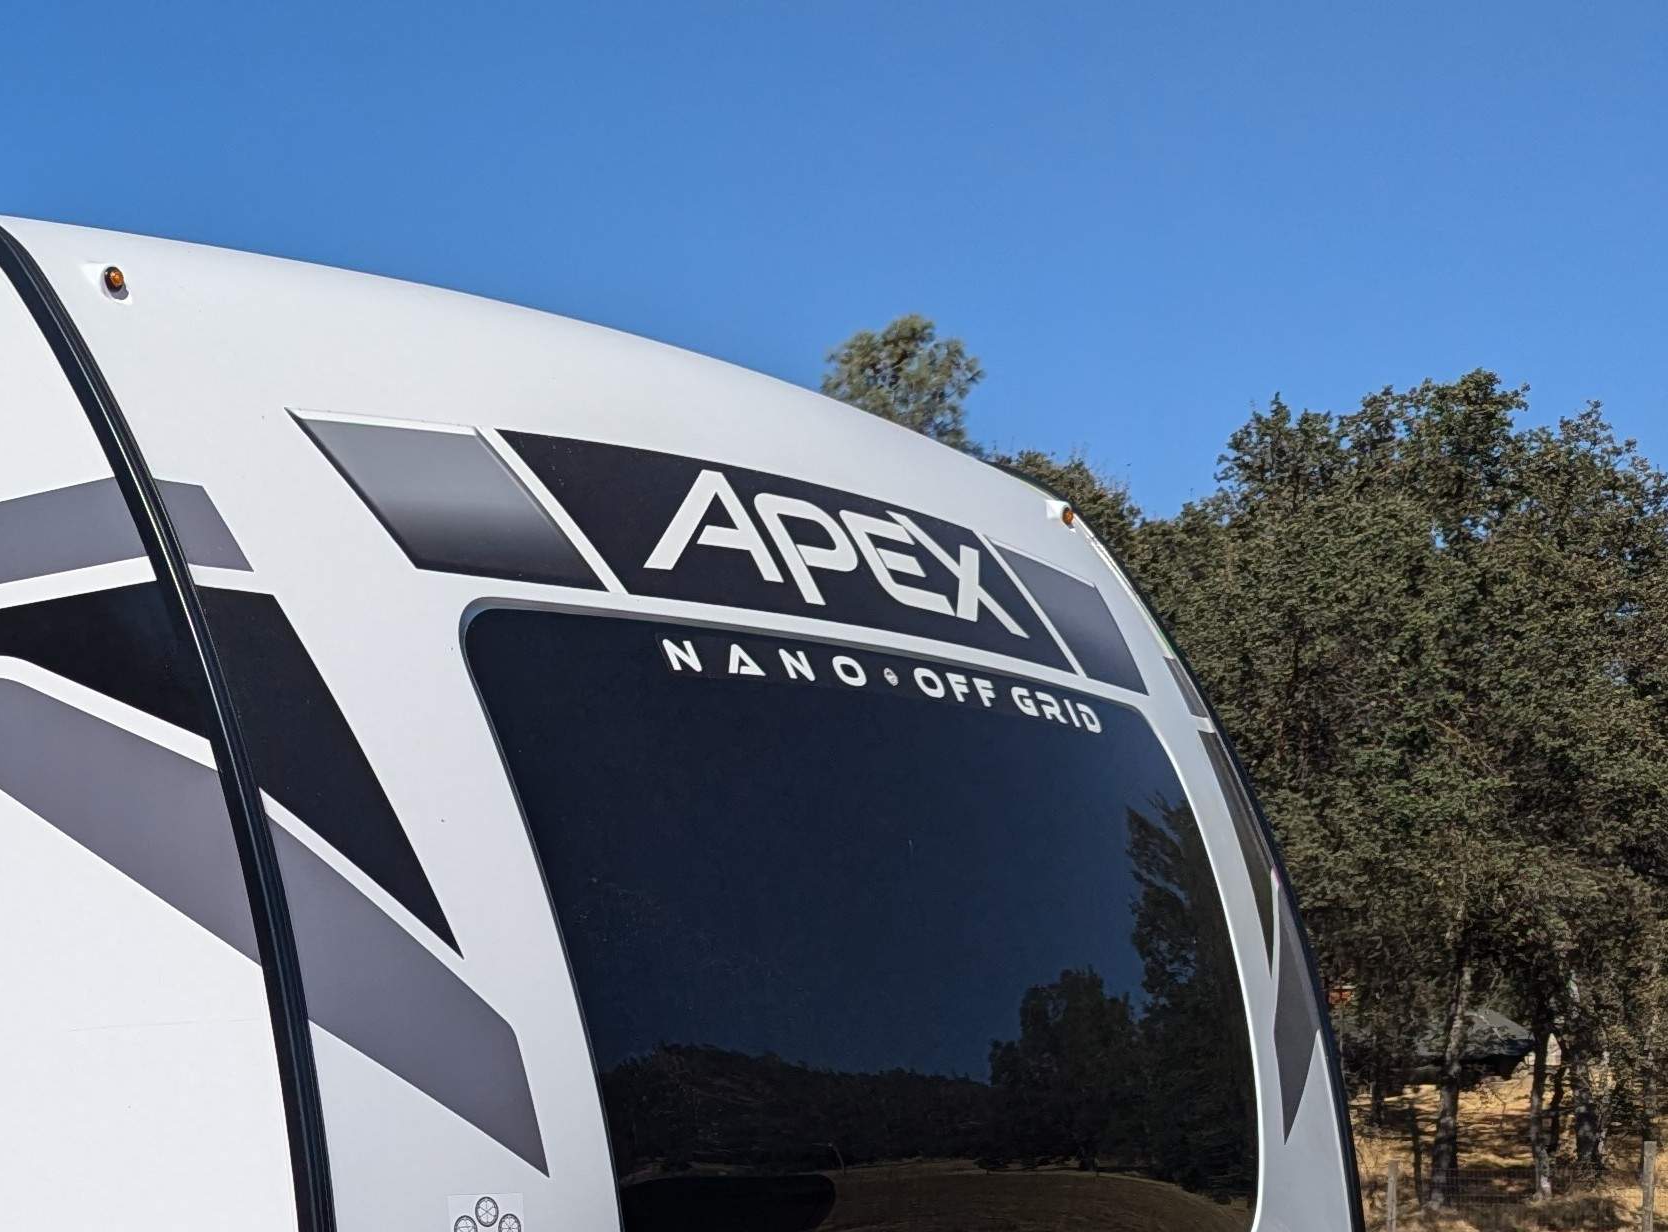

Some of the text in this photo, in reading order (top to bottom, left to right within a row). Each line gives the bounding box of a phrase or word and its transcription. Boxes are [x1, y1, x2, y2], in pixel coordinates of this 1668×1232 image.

[644, 469, 1029, 638] APEX
[661, 637, 1102, 733] NANO OFF GRID
